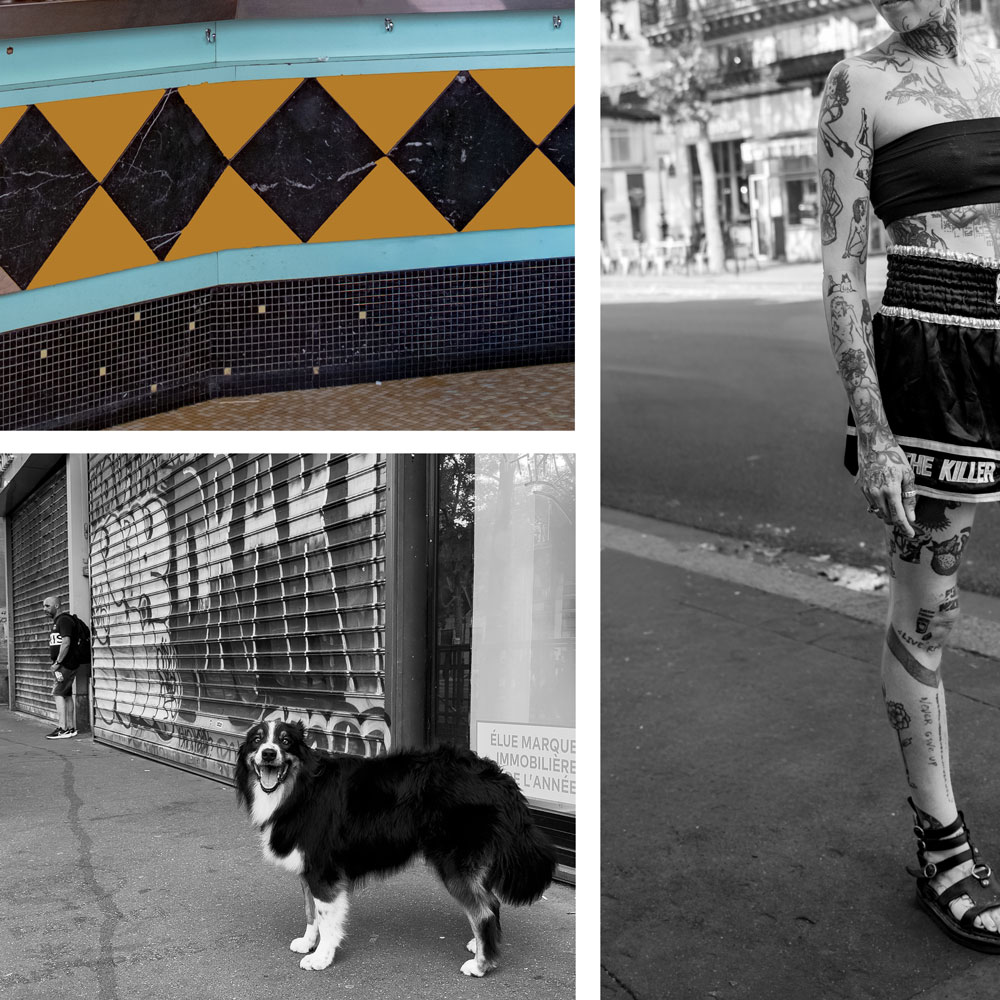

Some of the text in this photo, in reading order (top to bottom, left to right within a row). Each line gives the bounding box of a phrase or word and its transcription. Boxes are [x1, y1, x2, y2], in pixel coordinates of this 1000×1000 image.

[938, 458, 996, 484] KILLER
[490, 729, 576, 754] ÉLUE MARQUE
[497, 751, 576, 774] IMMOBILIÈRE
[524, 774, 576, 795] L'ANNÉE
